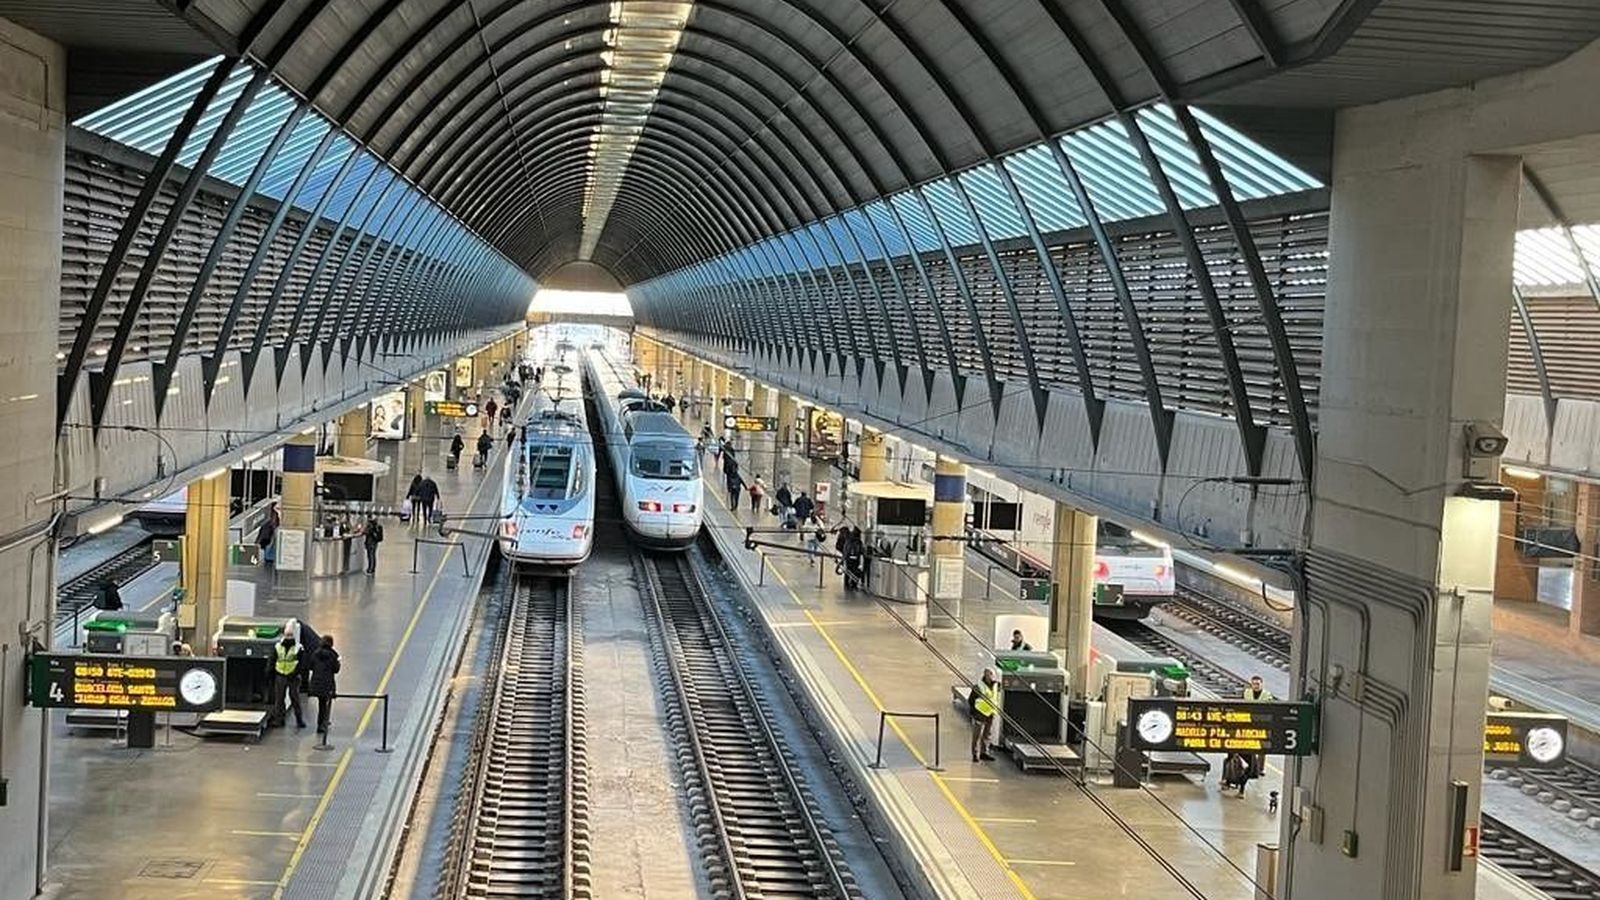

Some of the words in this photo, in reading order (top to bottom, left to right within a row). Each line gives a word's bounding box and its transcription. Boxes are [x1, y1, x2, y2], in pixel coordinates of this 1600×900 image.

[153, 550, 161, 561] 5
[250, 554, 258, 565] 4
[1020, 588, 1028, 600] 3
[49, 681, 65, 703] 4
[1174, 727, 1207, 737] MADRID
[1210, 728, 1231, 738] PTA.
[1235, 729, 1267, 739] ATOCHA
[1284, 729, 1298, 750] 3
